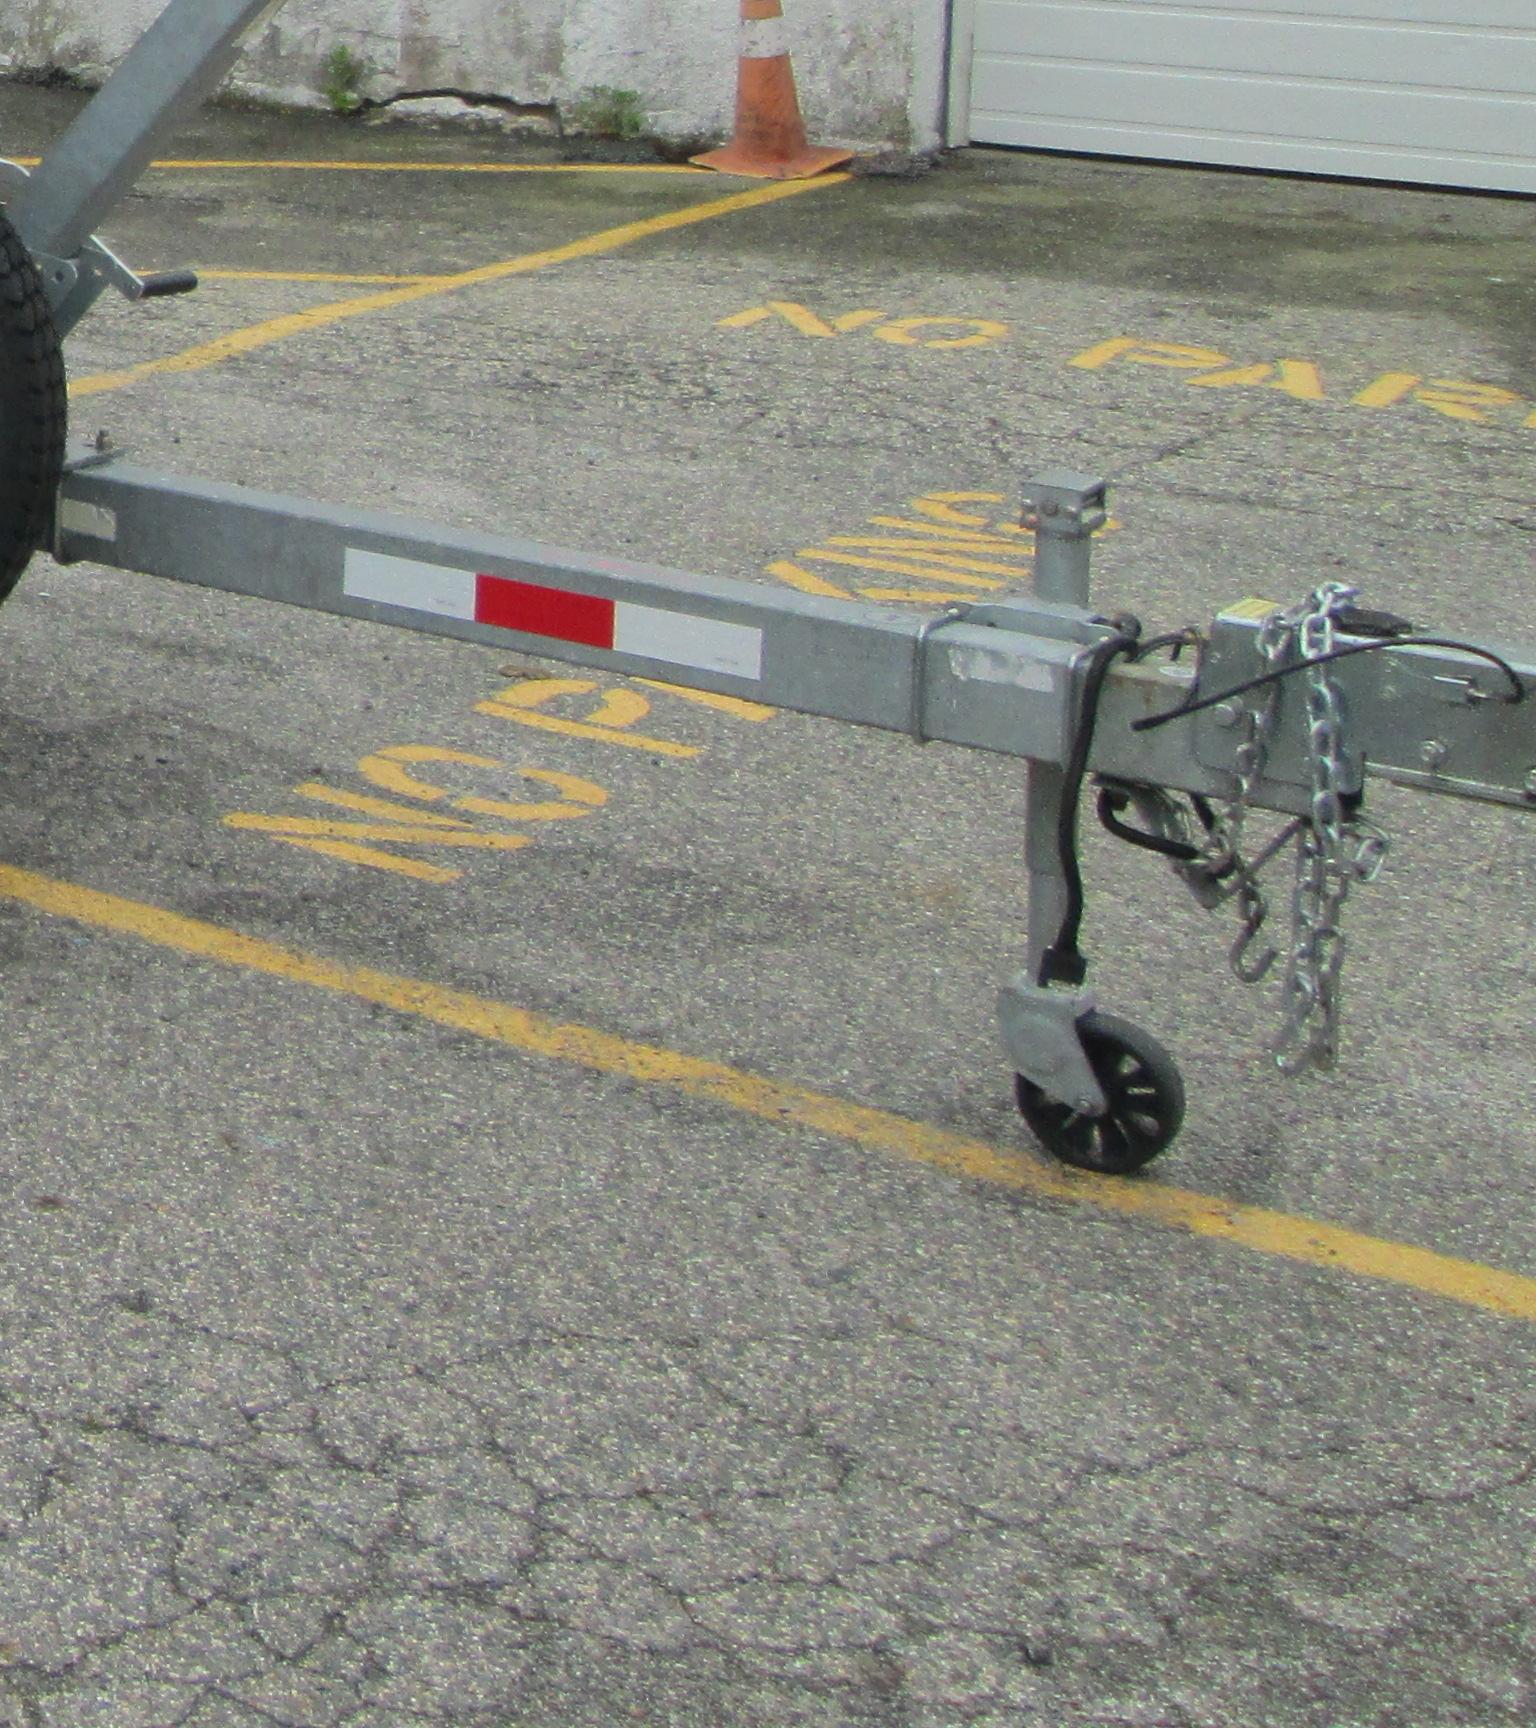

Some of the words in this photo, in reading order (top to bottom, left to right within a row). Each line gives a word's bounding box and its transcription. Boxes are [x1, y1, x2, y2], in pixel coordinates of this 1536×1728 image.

[716, 300, 1009, 349] NO
[1066, 336, 1536, 429] PAR
[222, 744, 609, 884] NO
